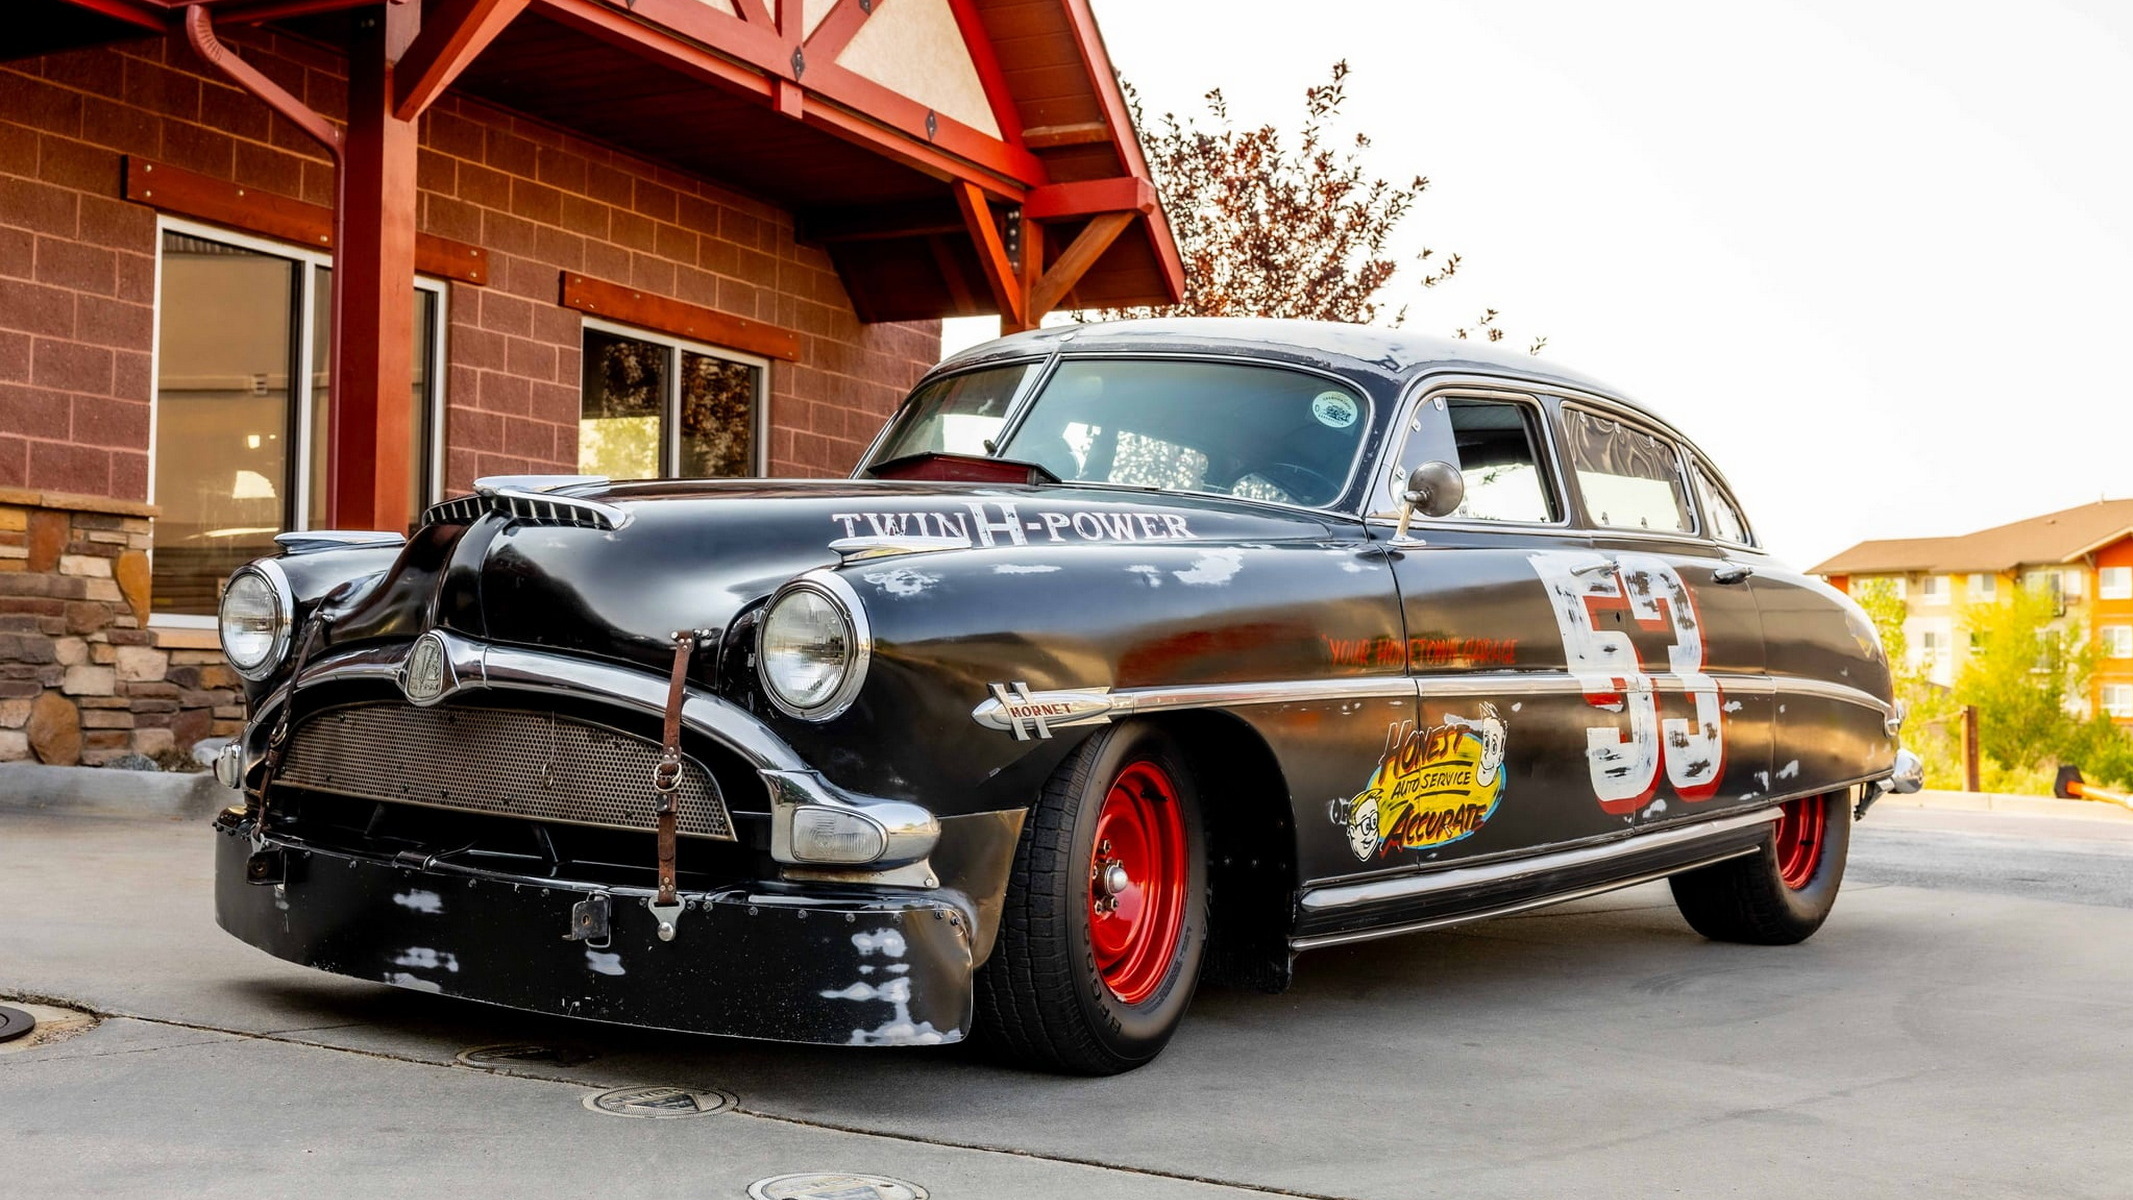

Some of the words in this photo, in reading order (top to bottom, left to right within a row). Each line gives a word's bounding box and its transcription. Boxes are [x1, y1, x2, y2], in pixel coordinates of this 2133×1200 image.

[832, 513, 972, 542] TWIN
[1526, 549, 1727, 812] 53
[1010, 703, 1071, 718] HORNET
[1378, 720, 1471, 786] HONEST
[1391, 777, 1419, 799] AUTO
[1420, 771, 1471, 788] SERVICE
[1380, 802, 1488, 857] ACCURATE
